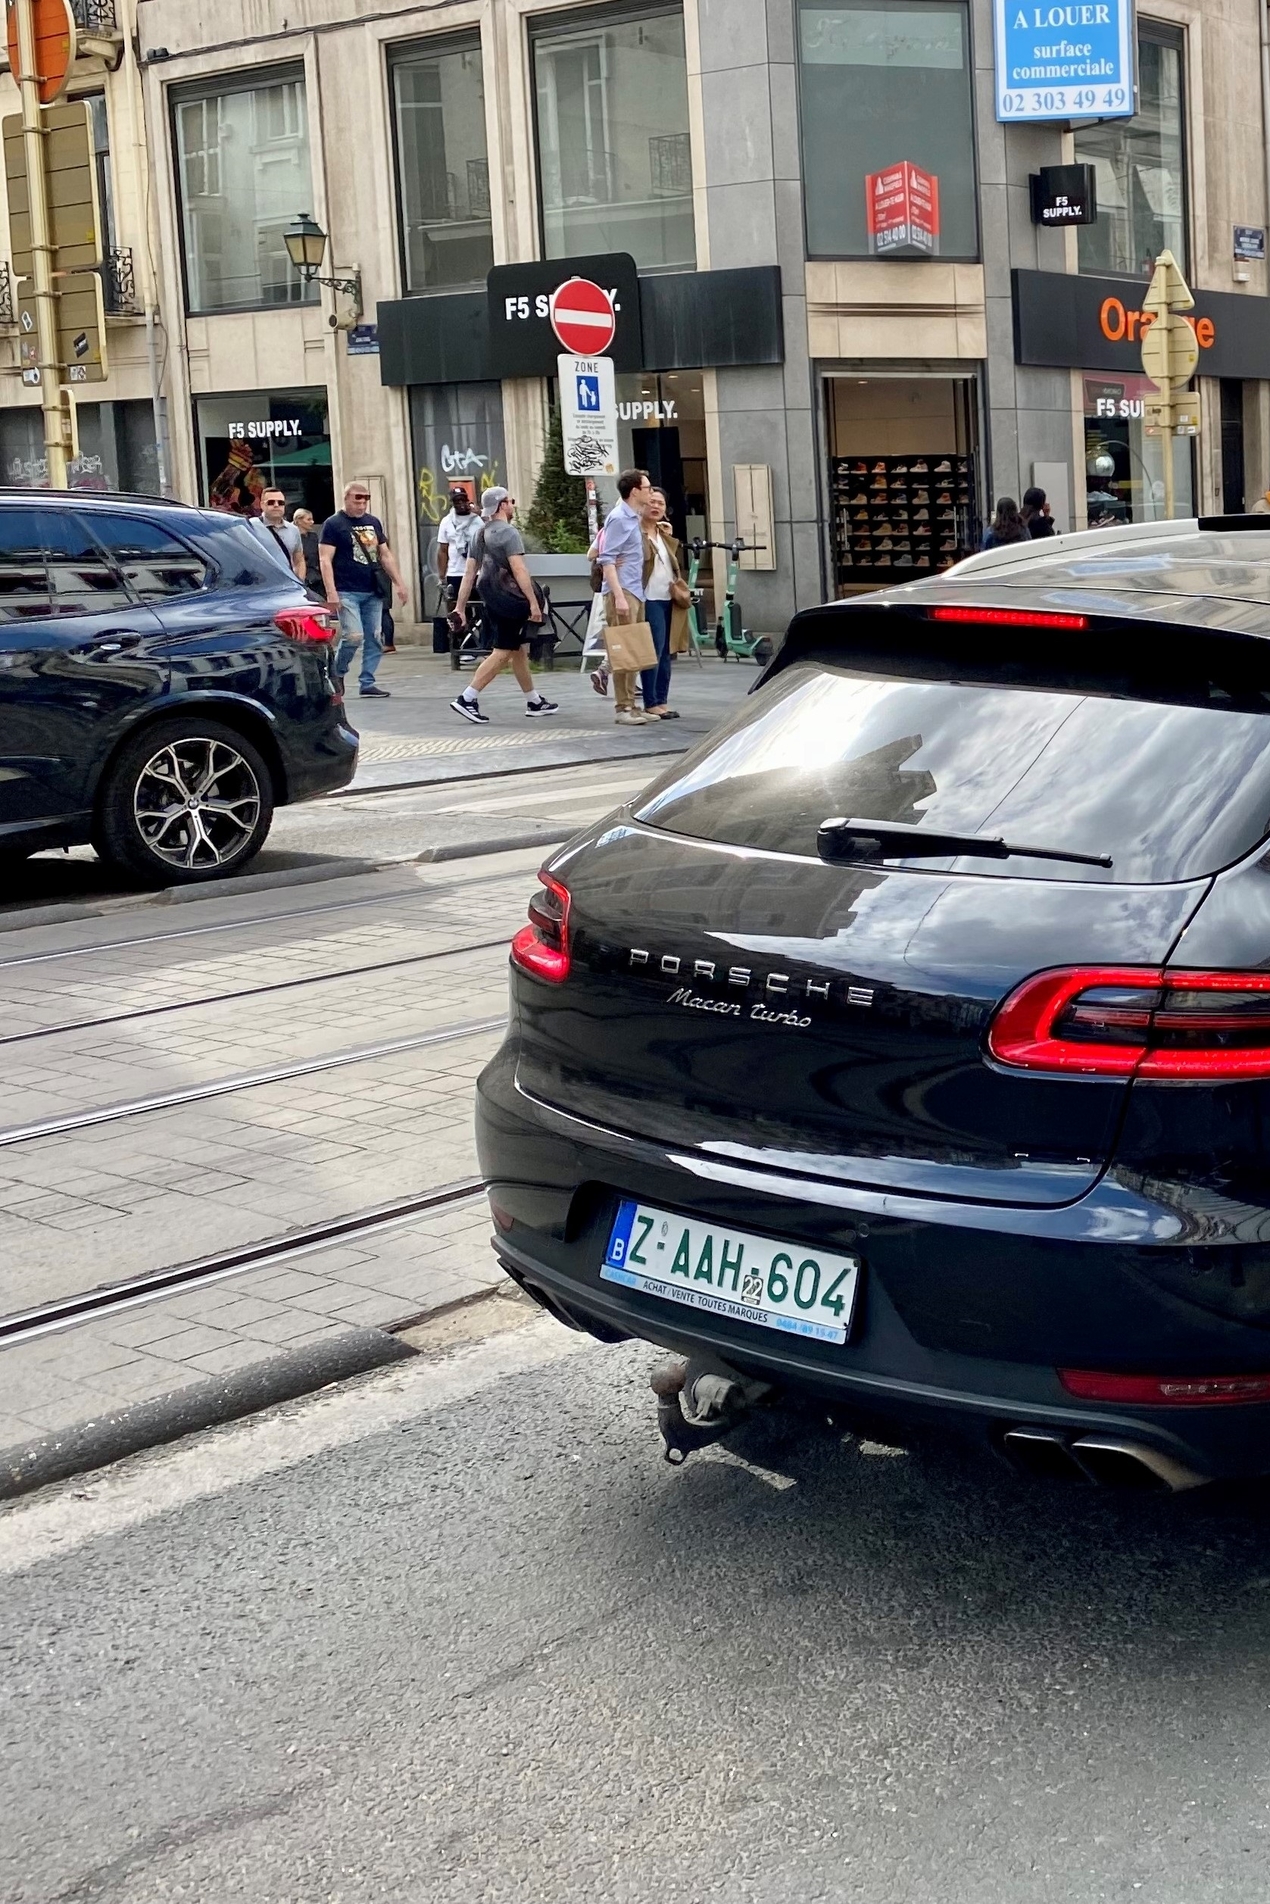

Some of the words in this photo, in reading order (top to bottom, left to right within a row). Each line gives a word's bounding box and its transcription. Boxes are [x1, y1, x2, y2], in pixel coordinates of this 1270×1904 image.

[1013, 9, 1029, 29] A
[1033, 4, 1111, 28] LOUER
[1033, 40, 1092, 59] surface
[1012, 58, 1114, 80] commerciale
[1003, 93, 1025, 112] 02
[1032, 91, 1066, 112] 303
[1073, 89, 1096, 109] 49
[1103, 88, 1126, 107] 49
[1043, 206, 1083, 218] SUPPLY.
[1055, 196, 1068, 206] F5
[505, 297, 530, 320] F5
[574, 361, 599, 373] ZONE
[1096, 398, 1116, 417] F5
[228, 423, 245, 439] F5
[248, 420, 303, 438] SUPPLY.
[629, 948, 874, 1007] PORSCHE
[667, 987, 741, 1016] Macan
[750, 1003, 812, 1028] turbo
[611, 1238, 625, 1261] B
[629, 1215, 852, 1317] Z-AAH-604
[743, 1276, 763, 1297] 22
[643, 1280, 667, 1295] ACHAT
[671, 1288, 695, 1304] VENTE
[698, 1296, 726, 1312] TOUTES
[728, 1305, 768, 1323] MARQUES
